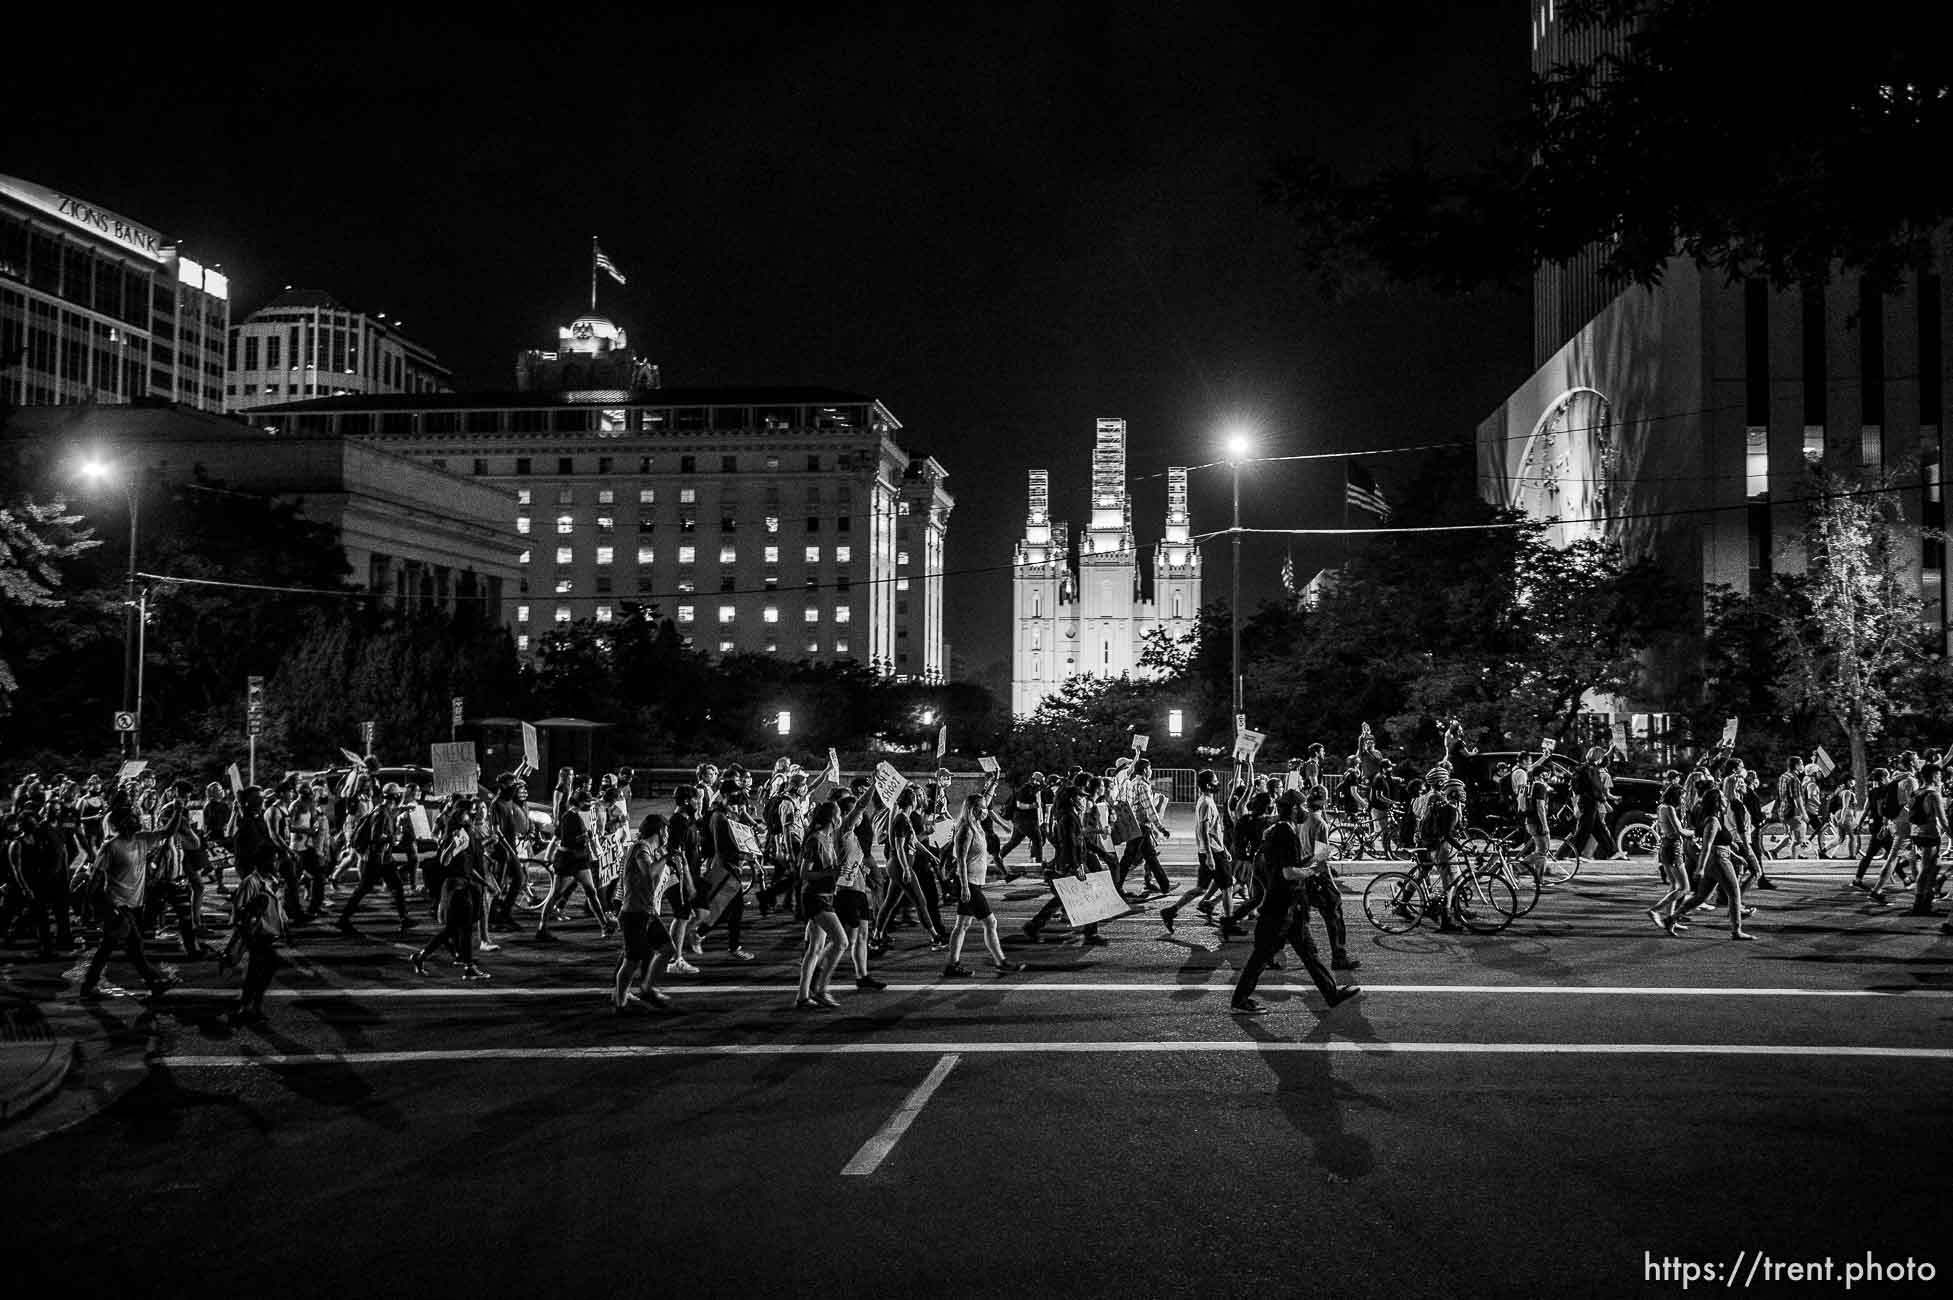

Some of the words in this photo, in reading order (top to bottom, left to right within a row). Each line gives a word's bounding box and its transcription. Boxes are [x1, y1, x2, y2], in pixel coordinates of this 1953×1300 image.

[59, 198, 108, 232] ZIONS
[115, 221, 160, 257] BANK
[881, 776, 900, 802] SHOOT
